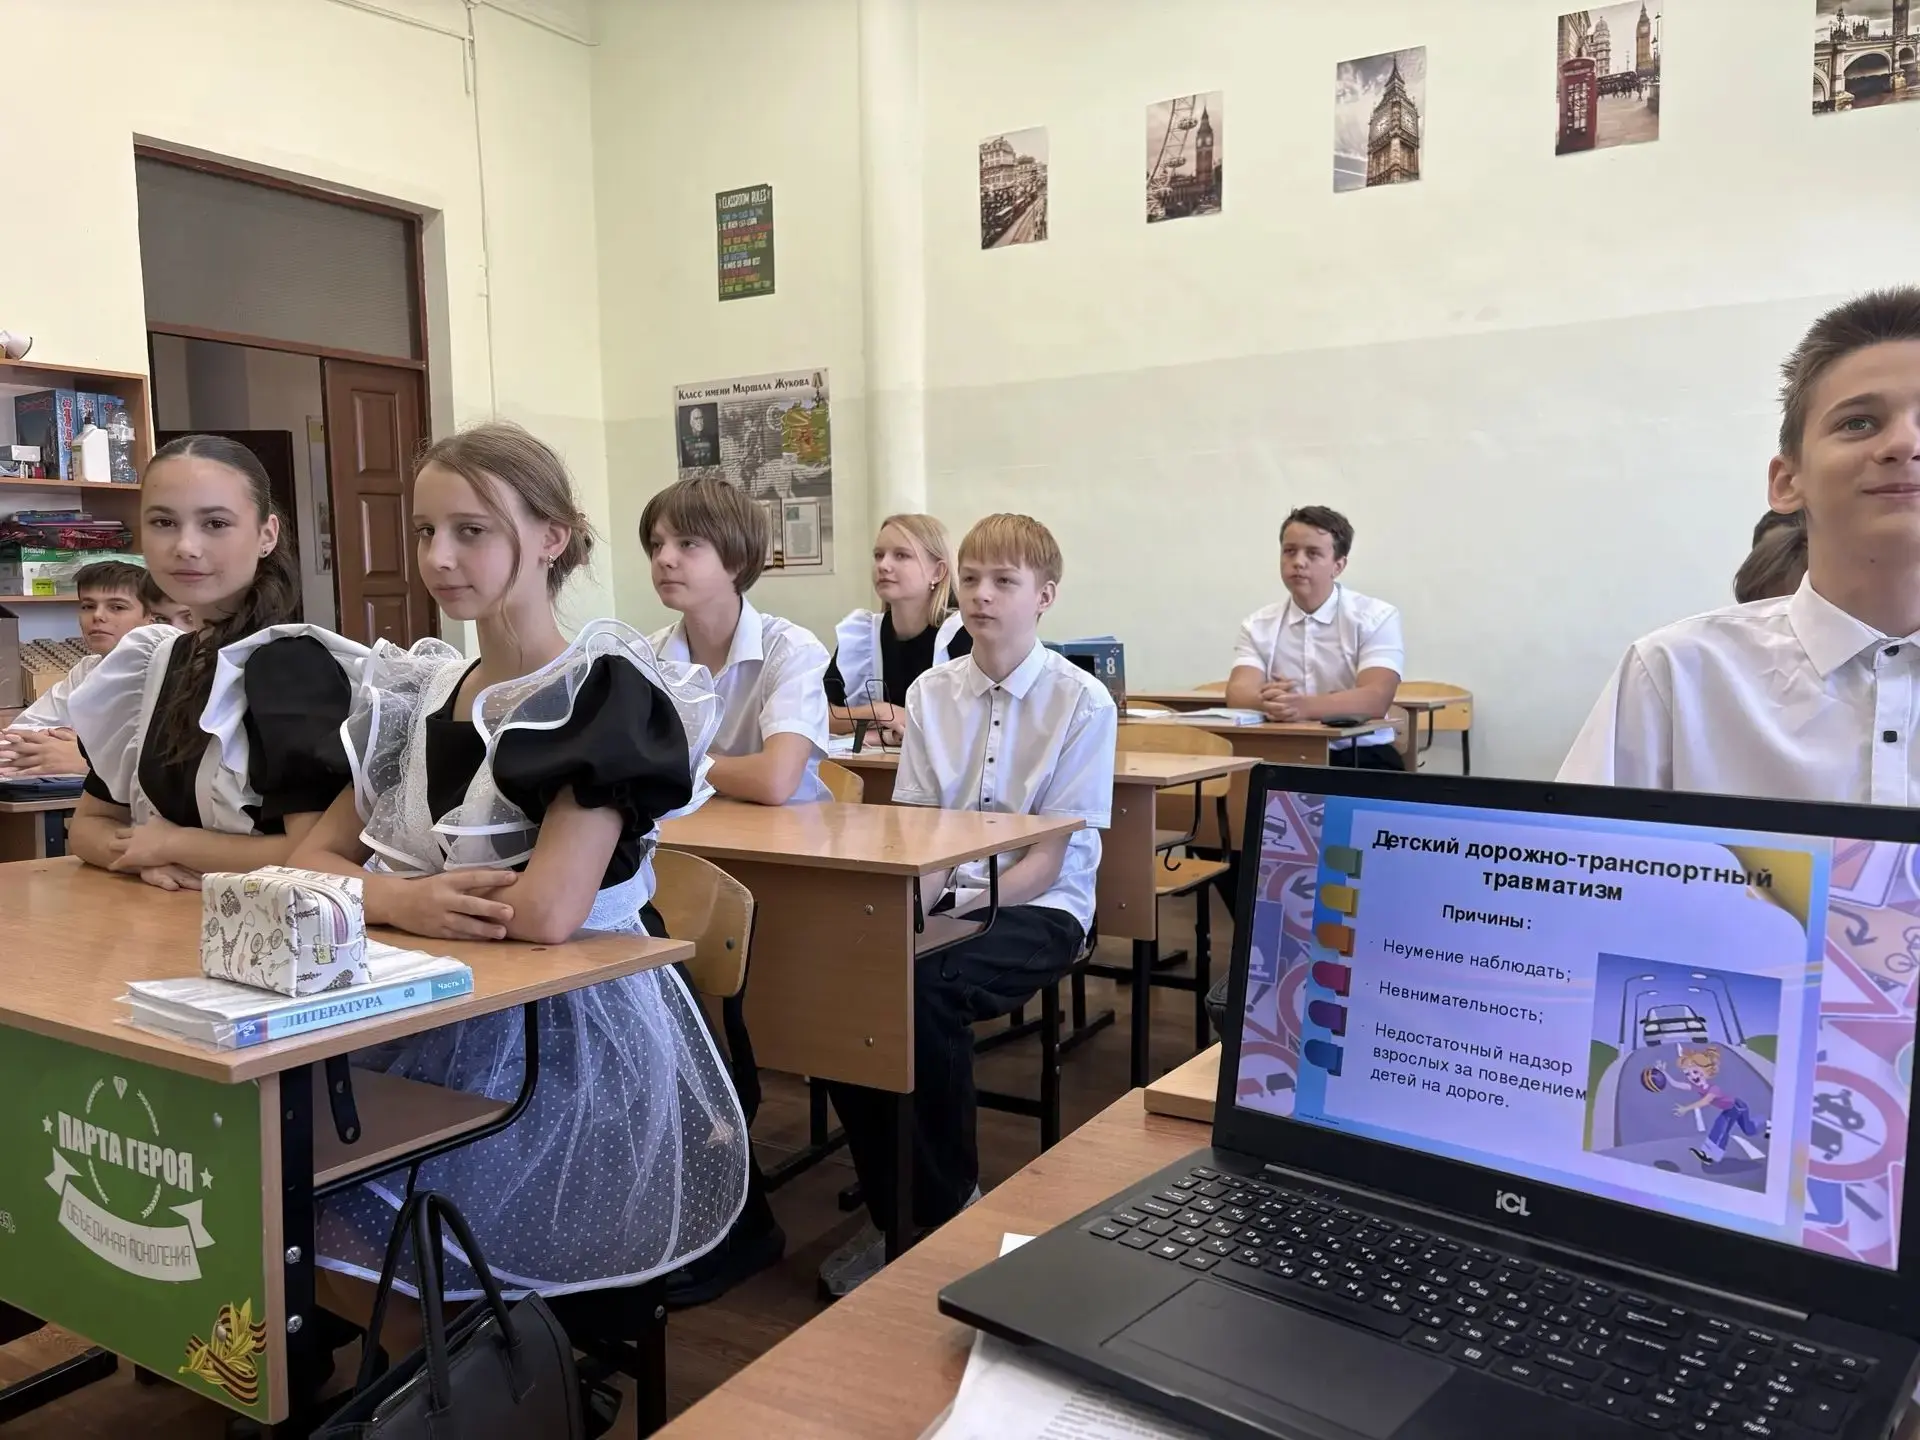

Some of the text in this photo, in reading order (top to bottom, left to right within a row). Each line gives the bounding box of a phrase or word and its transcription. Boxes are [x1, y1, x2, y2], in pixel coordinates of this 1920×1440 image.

[722, 189, 767, 209] CLASSROOM RULES
[1106, 656, 1116, 675] 8
[1372, 829, 1773, 889] Детский дорожно-транспортный
[1482, 870, 1623, 901] травматизм
[1383, 938, 1572, 983] Неумение наблюдать;
[437, 980, 461, 990] Часть
[1378, 980, 1544, 1024] Невнимательность;
[282, 994, 384, 1030] ЛИТЕРАТУРА
[1375, 1022, 1573, 1077] Недостаточный надзор
[1370, 1067, 1510, 1108] детей на дороге.
[1373, 1046, 1587, 1101] взрослых за поведением
[57, 1110, 194, 1193] ПАРТА ГЕРОЯ
